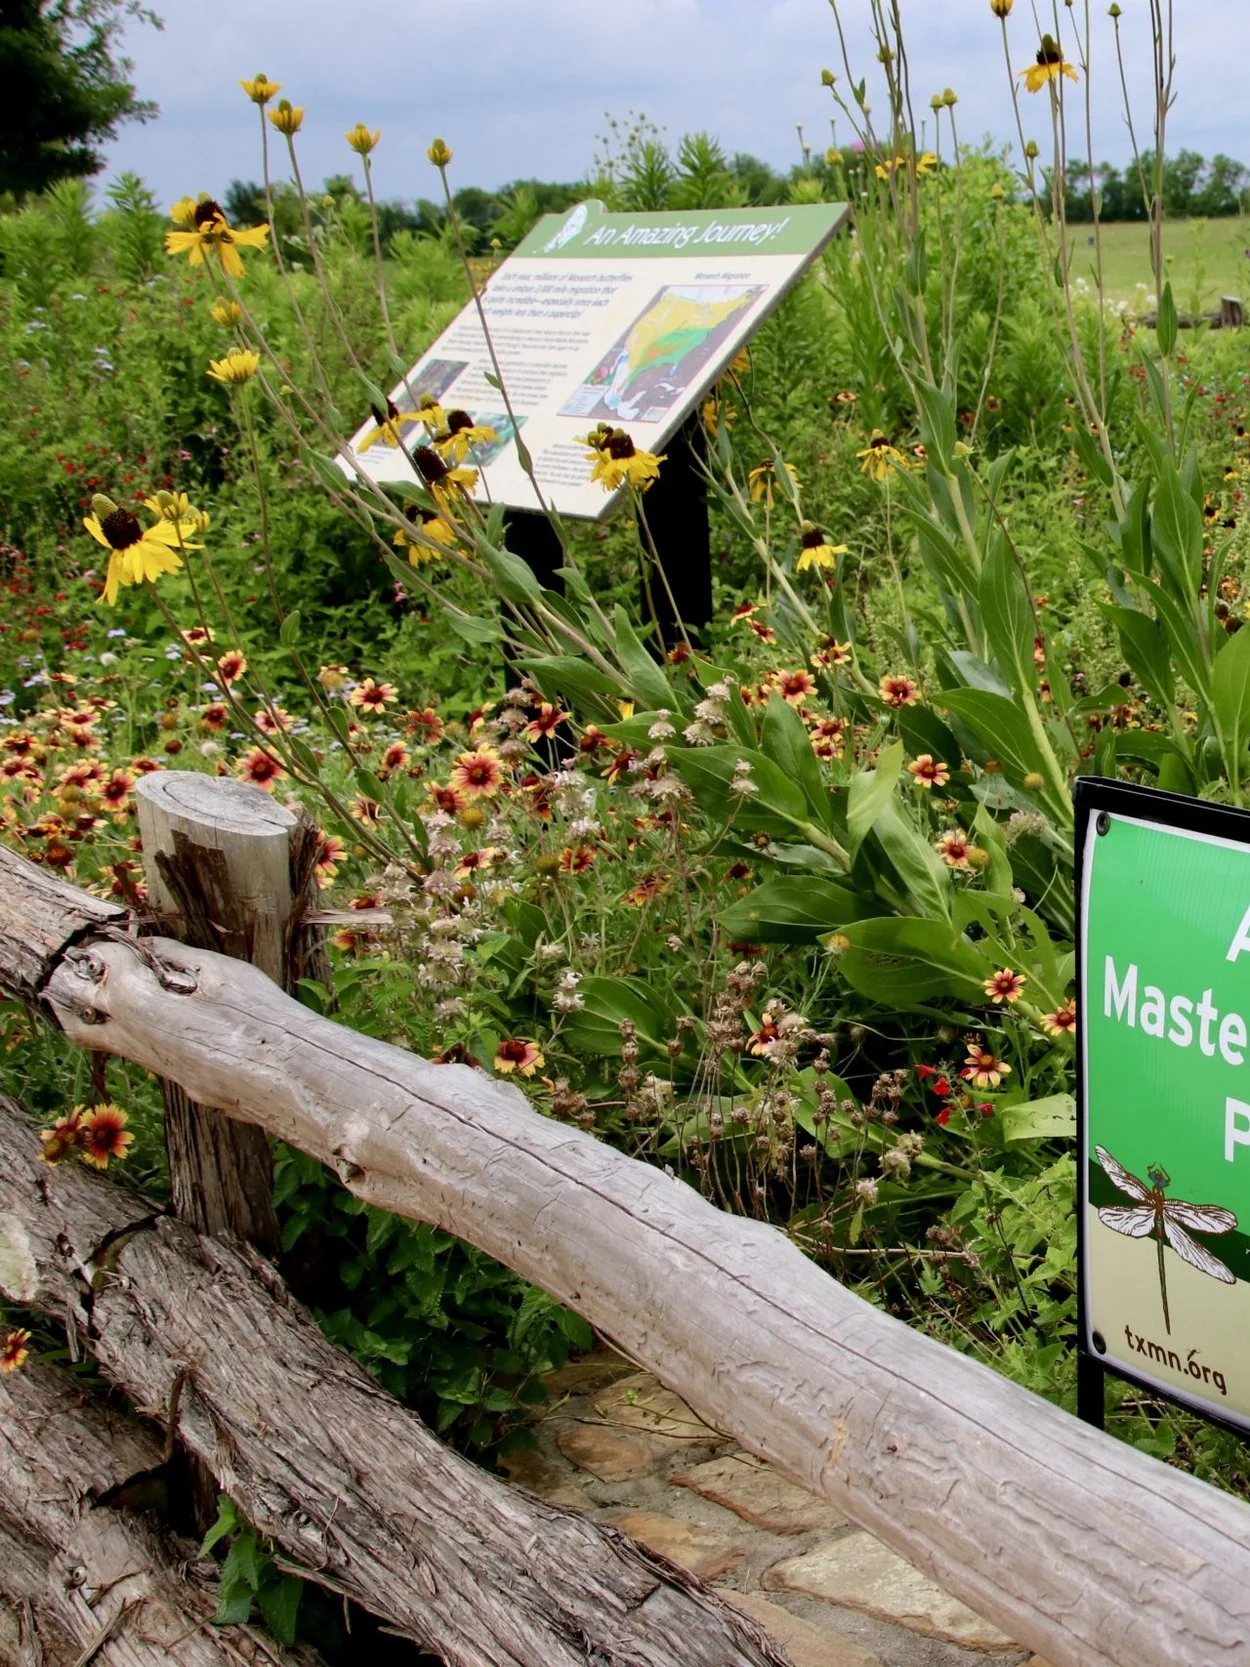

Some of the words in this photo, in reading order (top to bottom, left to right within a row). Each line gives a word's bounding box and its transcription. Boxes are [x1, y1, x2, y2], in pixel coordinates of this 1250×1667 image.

[584, 225, 617, 245] An
[612, 222, 700, 249] Amazing
[693, 216, 791, 247] Journey!
[1124, 1324, 1228, 1396] txmn.org
